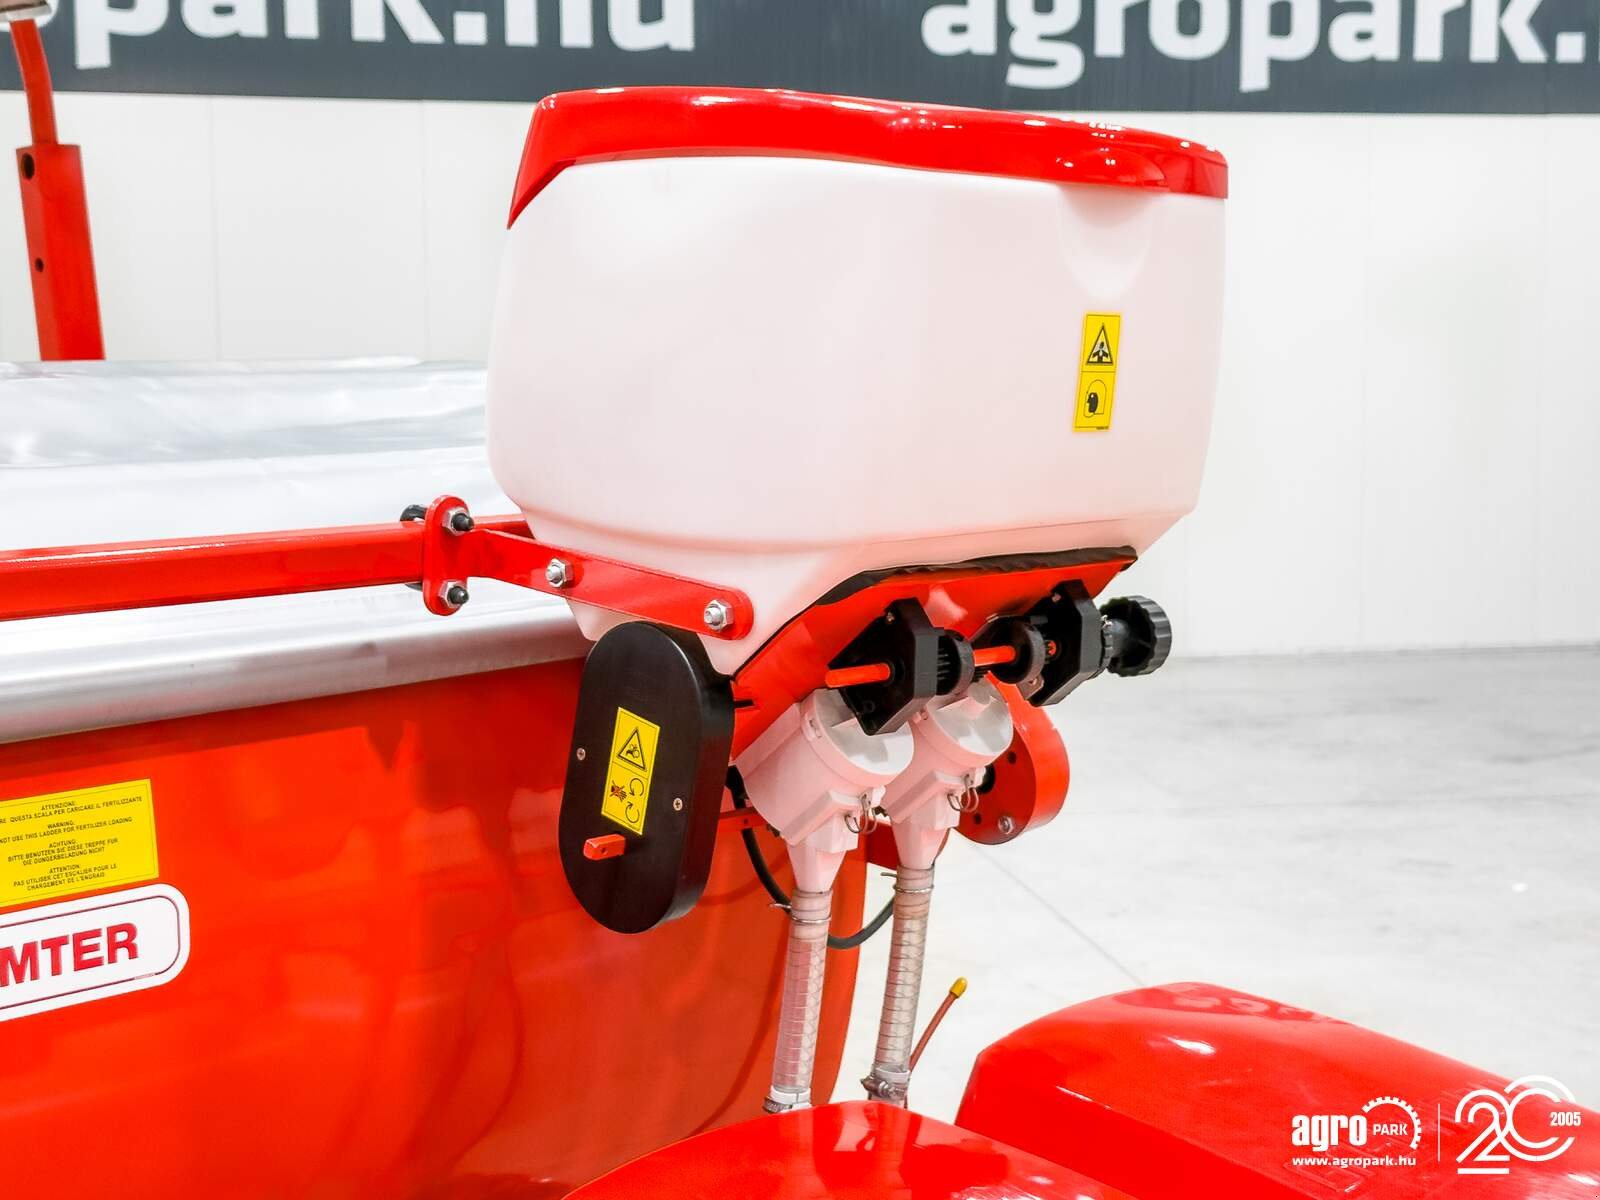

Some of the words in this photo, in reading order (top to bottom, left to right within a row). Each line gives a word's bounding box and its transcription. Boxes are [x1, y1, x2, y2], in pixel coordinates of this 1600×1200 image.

[10, 814, 31, 822] QUESTA
[34, 810, 52, 818] SCALA
[66, 803, 93, 813] CARICARE
[102, 795, 141, 807] FERTILIZZANTE
[39, 828, 61, 837] LADDER
[76, 820, 106, 830] FERTILIZER
[108, 816, 132, 825] LOADING
[8, 854, 23, 862] BITTE
[25, 848, 54, 858] BENUTZEN
[67, 843, 82, 851] DIESE
[85, 839, 105, 848] TREPPE
[88, 846, 104, 854] NICHT
[26, 875, 50, 884] UTILISER
[65, 867, 92, 877] ESCALIER
[94, 864, 108, 872] POUR
[27, 879, 65, 890] CHARGEMENT
[0, 922, 139, 988] MTER
